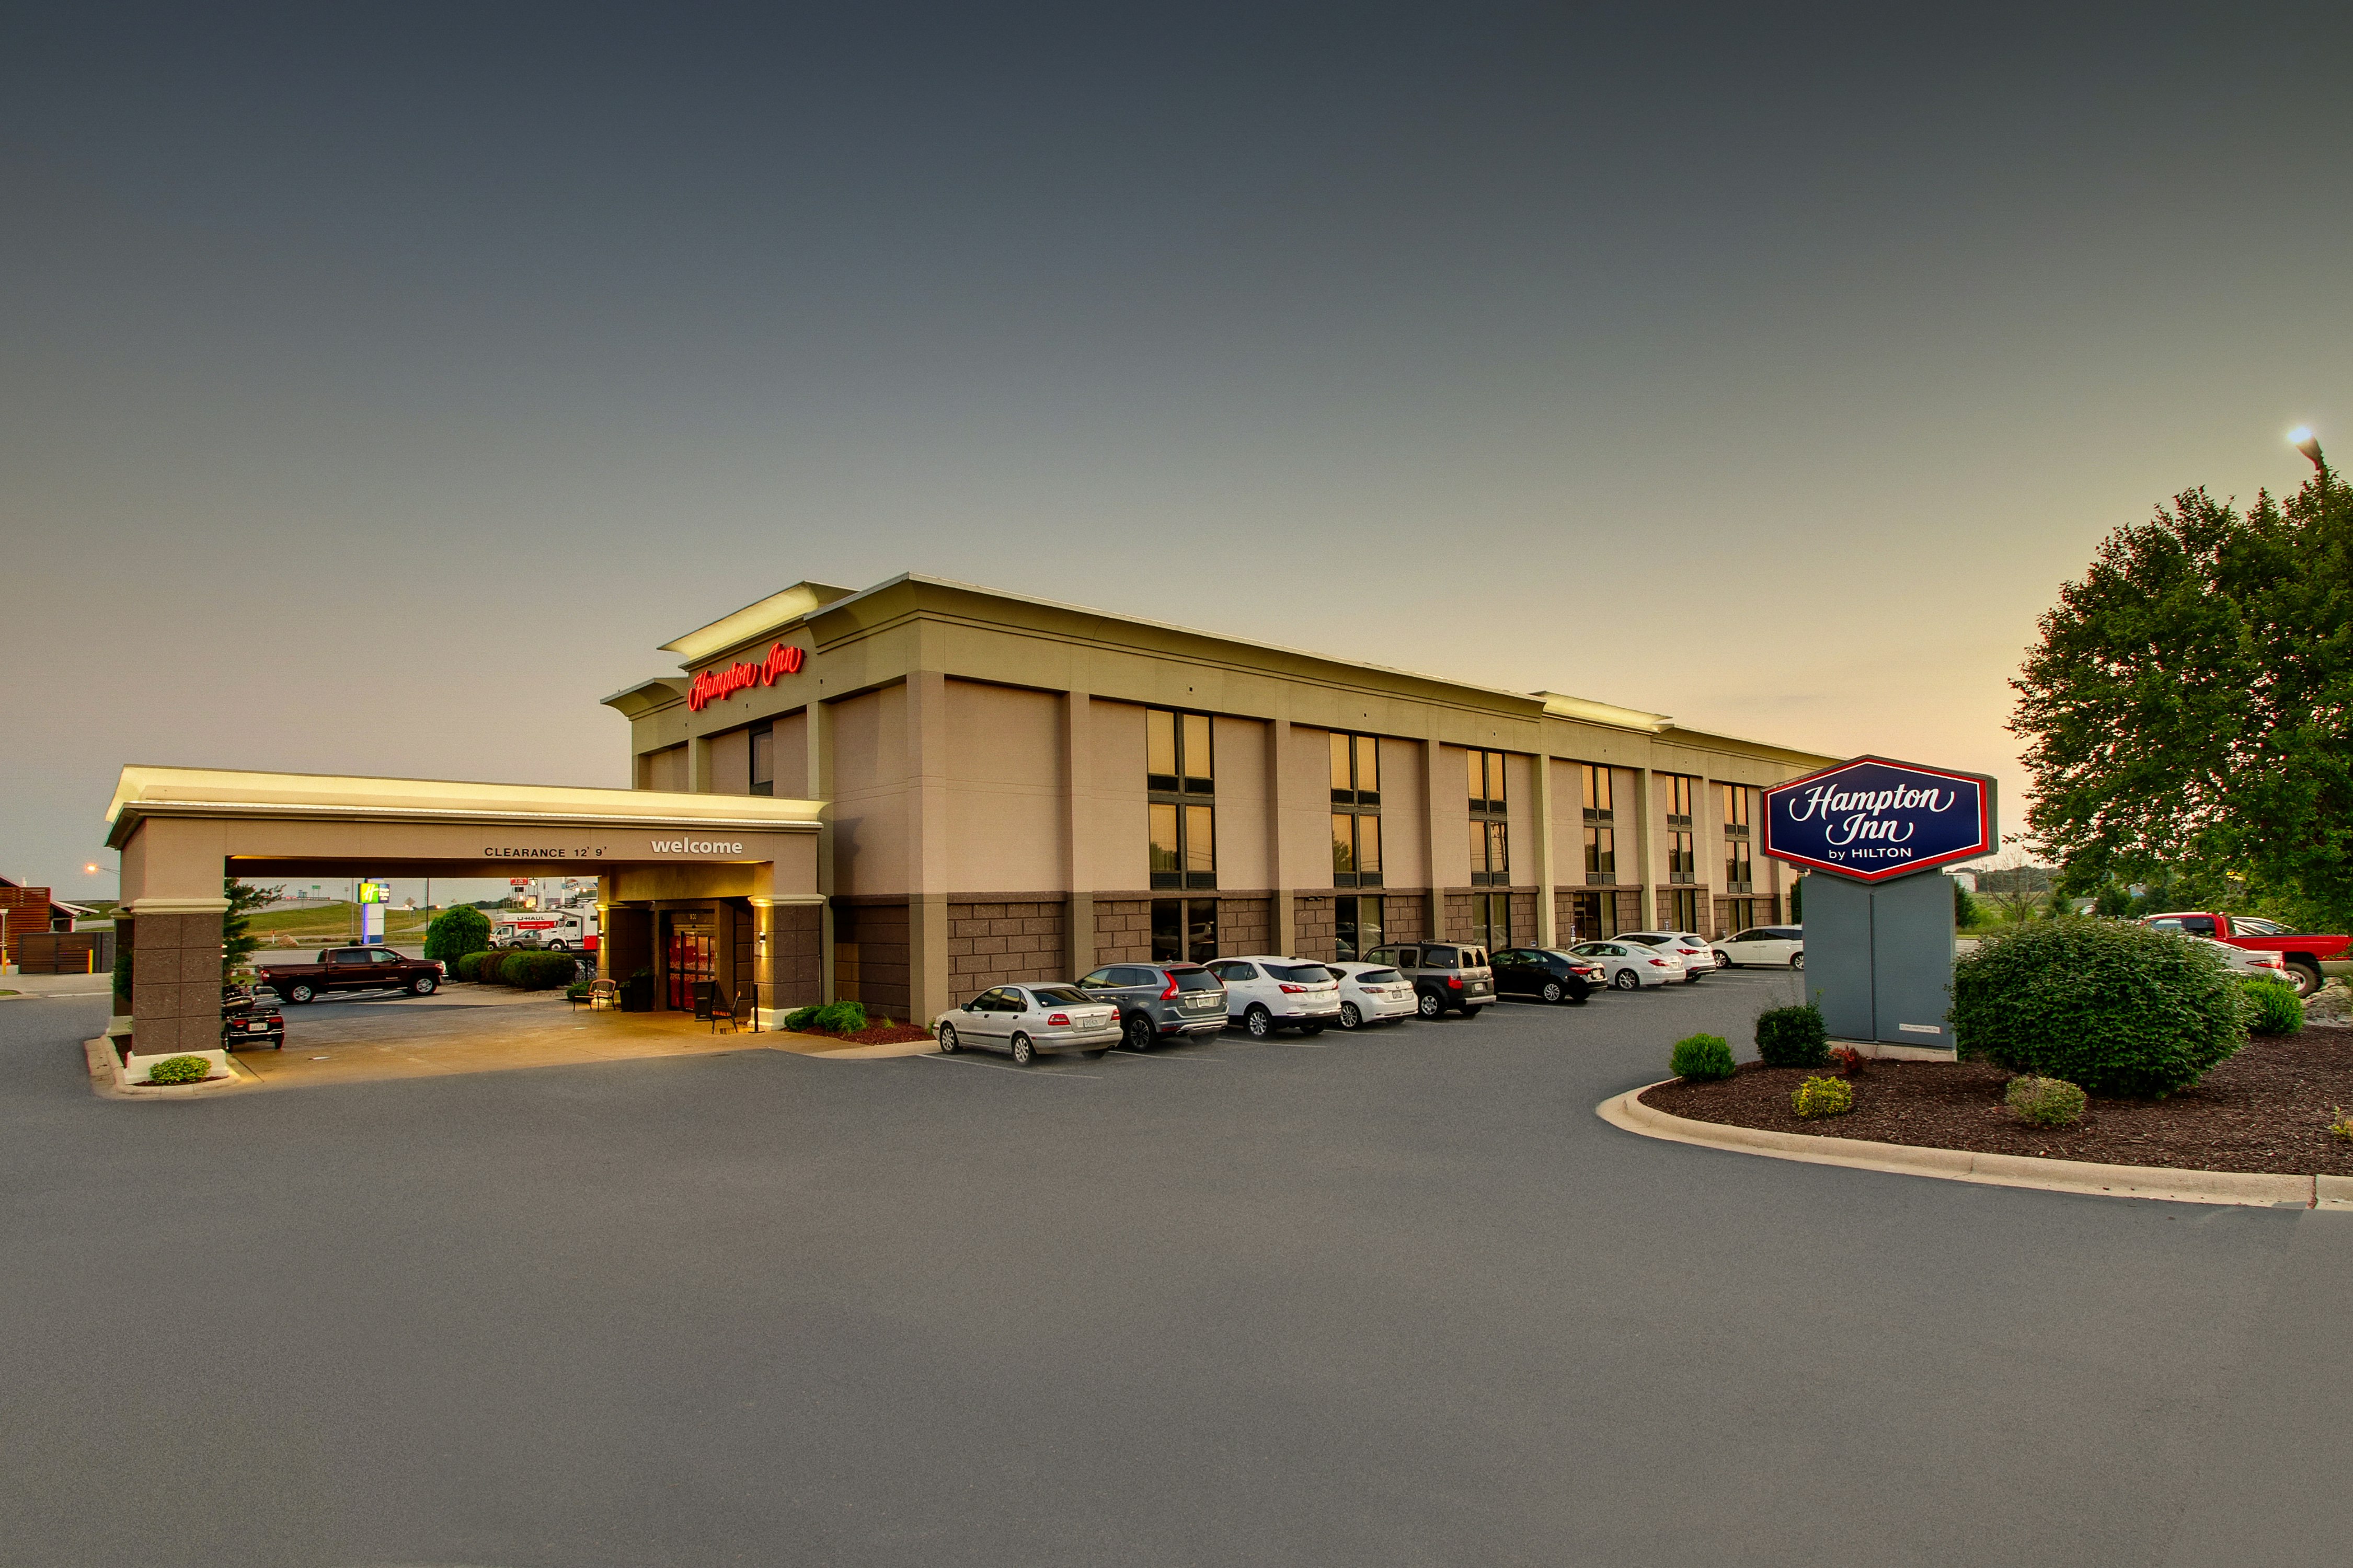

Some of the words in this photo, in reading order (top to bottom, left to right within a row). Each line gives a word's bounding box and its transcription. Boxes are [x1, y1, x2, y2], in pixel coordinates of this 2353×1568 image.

[687, 661, 761, 711] Hampton
[761, 642, 806, 686] Inn
[1789, 783, 1954, 821] Hampton
[1826, 813, 1913, 845] Inn
[484, 847, 566, 857] CLEARANCE
[651, 837, 743, 854] welcome
[1829, 850, 1845, 860] by
[1852, 848, 1912, 858] HILTON
